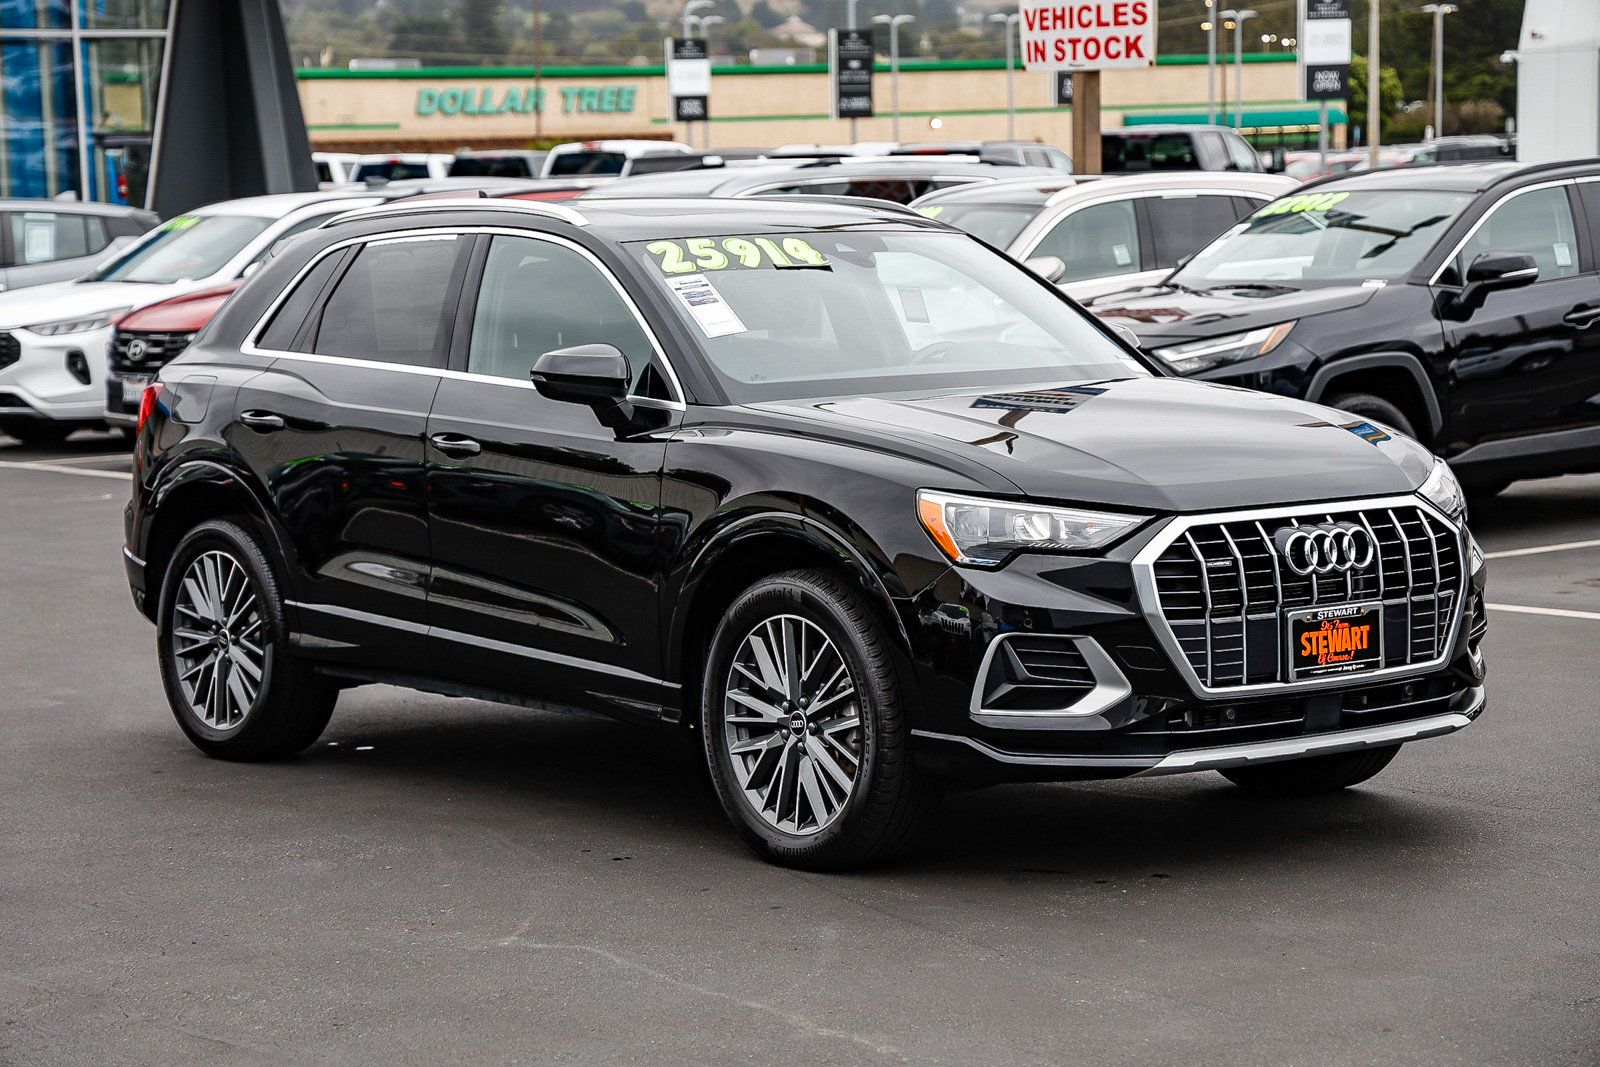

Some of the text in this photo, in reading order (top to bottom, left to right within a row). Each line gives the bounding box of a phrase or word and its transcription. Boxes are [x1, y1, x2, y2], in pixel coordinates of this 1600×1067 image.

[1024, 2, 1148, 31] VEHICLES
[1027, 34, 1145, 63] IN STOCK
[417, 85, 639, 116] DOLLAR TREE
[1317, 607, 1358, 620] STEWART
[1300, 624, 1371, 657] STEWART
